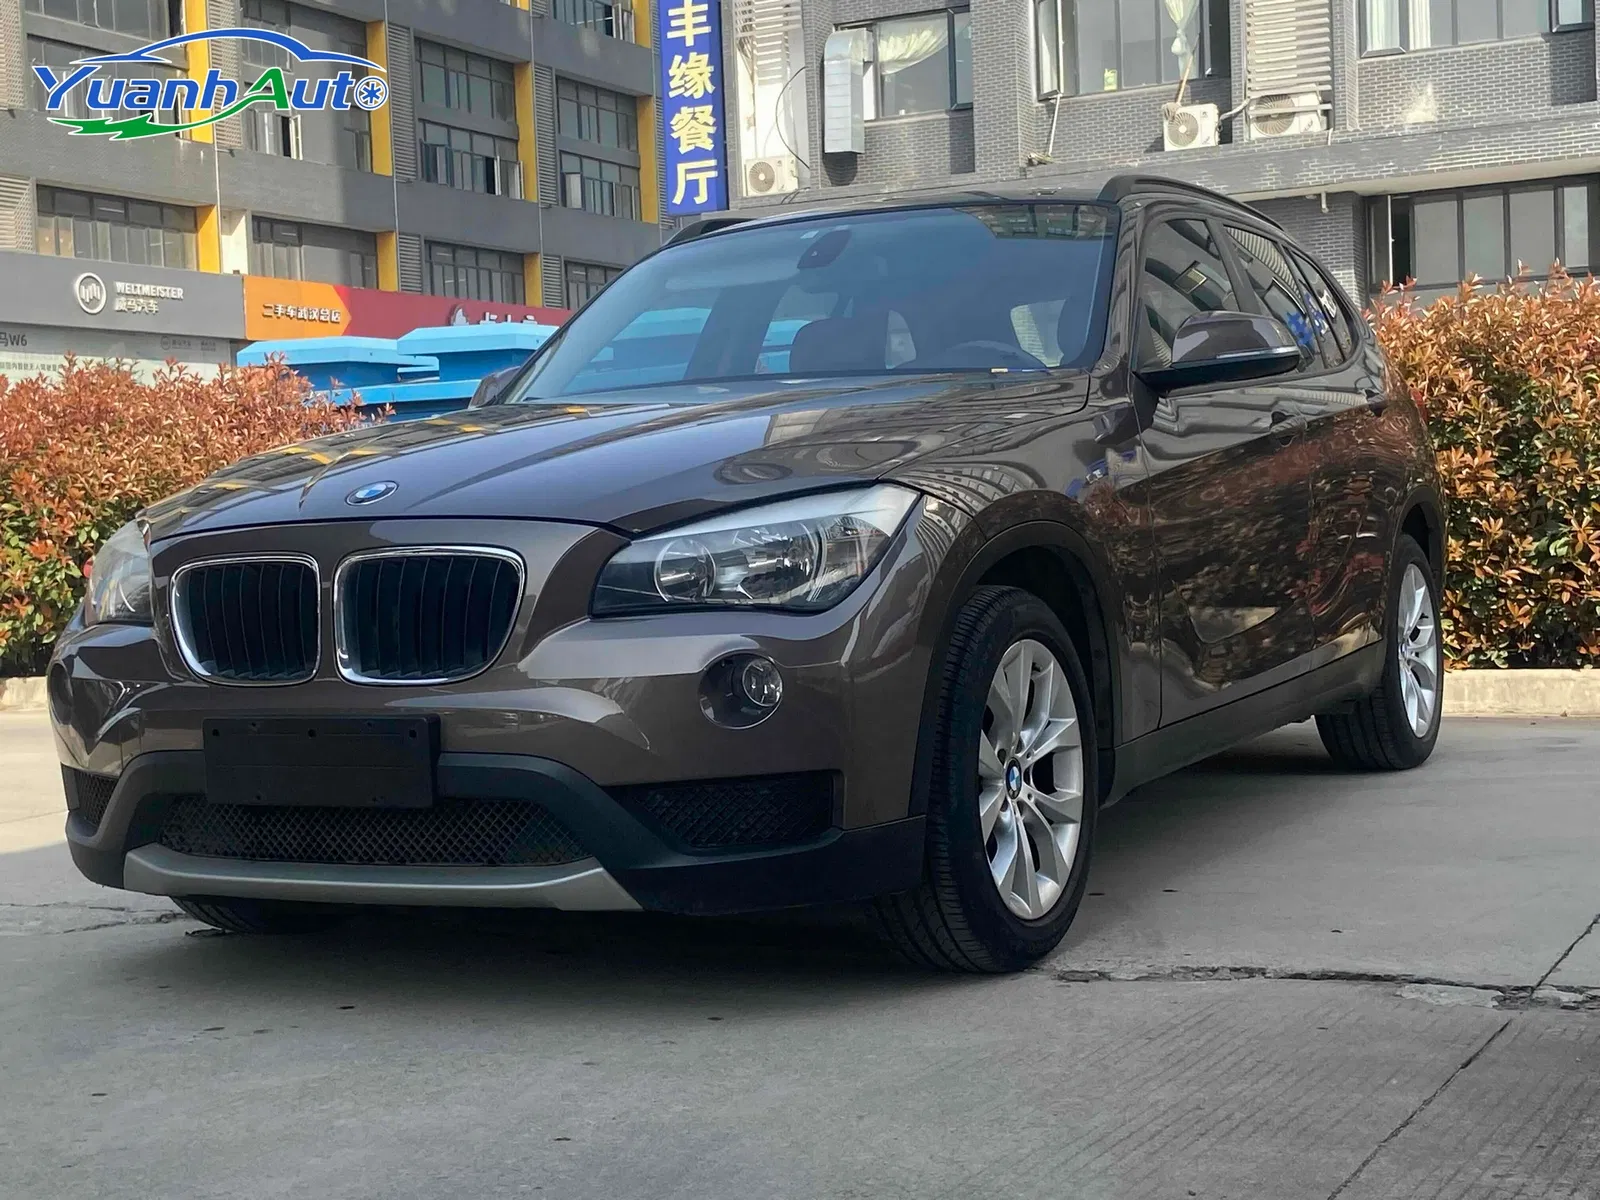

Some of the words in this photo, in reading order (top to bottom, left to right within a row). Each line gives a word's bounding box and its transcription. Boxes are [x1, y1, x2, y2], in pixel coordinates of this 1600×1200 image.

[667, 0, 718, 206] 丰缘餐厅
[115, 281, 184, 299] WELTMEISTER
[114, 297, 159, 314] 威马汽车
[262, 303, 341, 323] 二手车武汉总店
